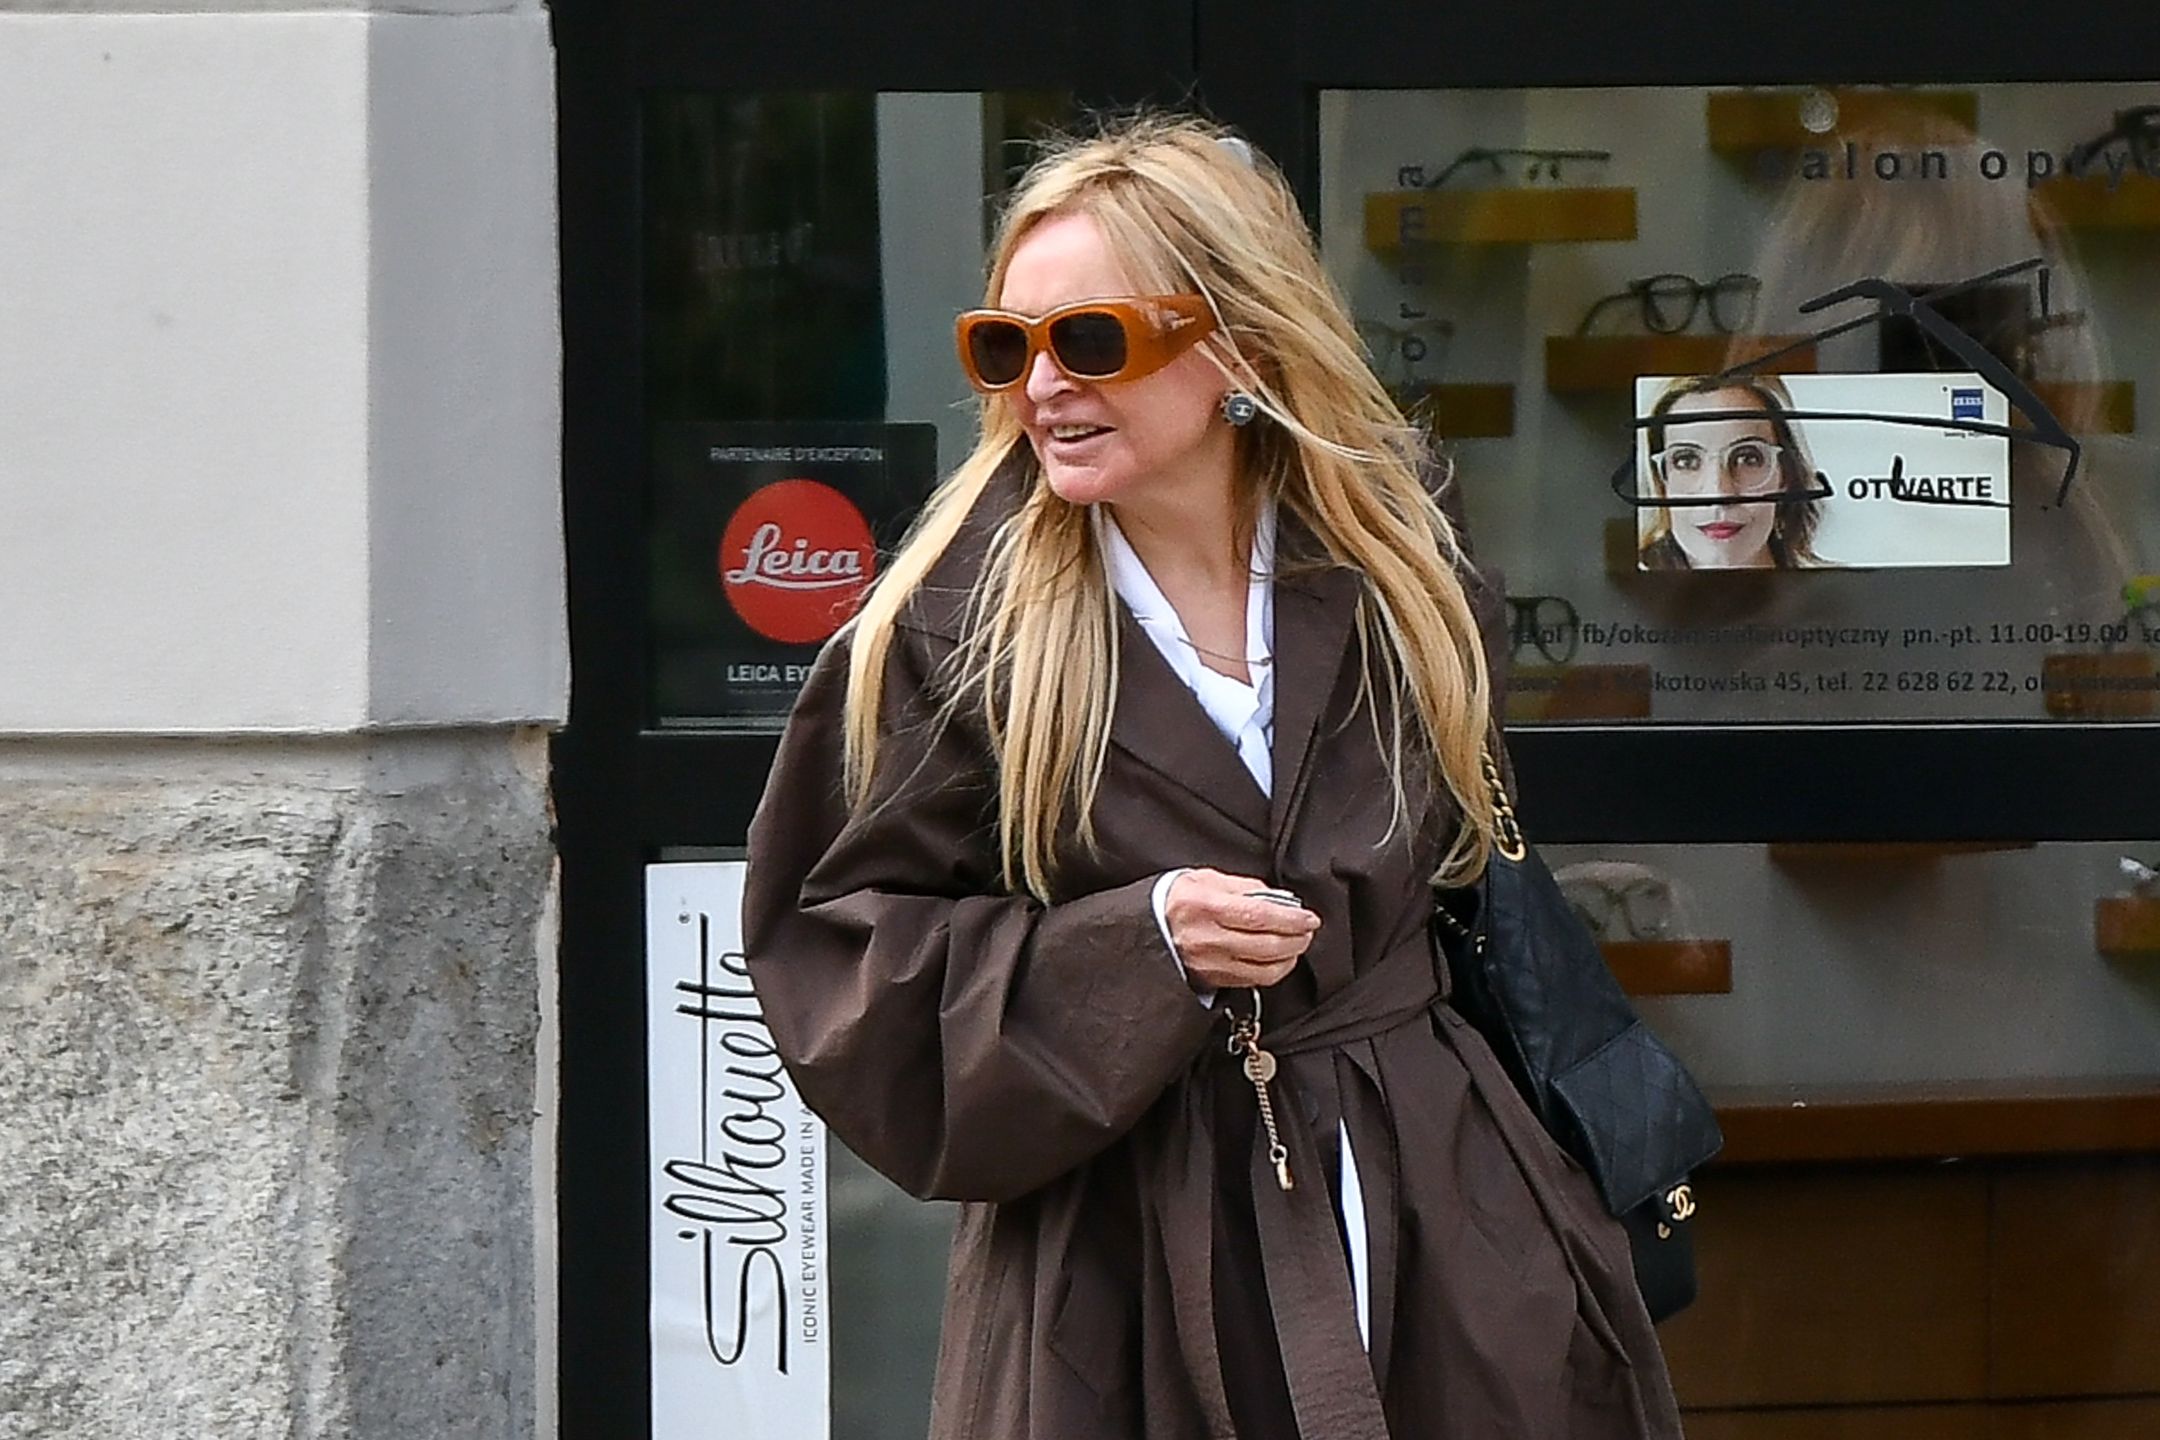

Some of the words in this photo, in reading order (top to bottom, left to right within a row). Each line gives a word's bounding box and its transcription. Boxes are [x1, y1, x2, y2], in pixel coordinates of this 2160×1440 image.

[1762, 142, 1948, 181] alon
[725, 522, 864, 590] Leica
[1990, 624, 2128, 644] 11.00-19.00
[727, 664, 782, 682] LEICA
[786, 664, 812, 682] EY
[1616, 672, 1767, 692] kotowska
[1773, 673, 1810, 696] 45,
[1817, 671, 1853, 692] tel.
[1863, 672, 1888, 691] 22
[1897, 672, 1939, 691] 628
[1947, 672, 1974, 691] 62
[1982, 672, 2017, 695] 22,
[800, 1120, 814, 1139] IN
[800, 1145, 816, 1195] MADE
[801, 1200, 817, 1282] EYEWEAR
[803, 1286, 818, 1343] ICONIC
